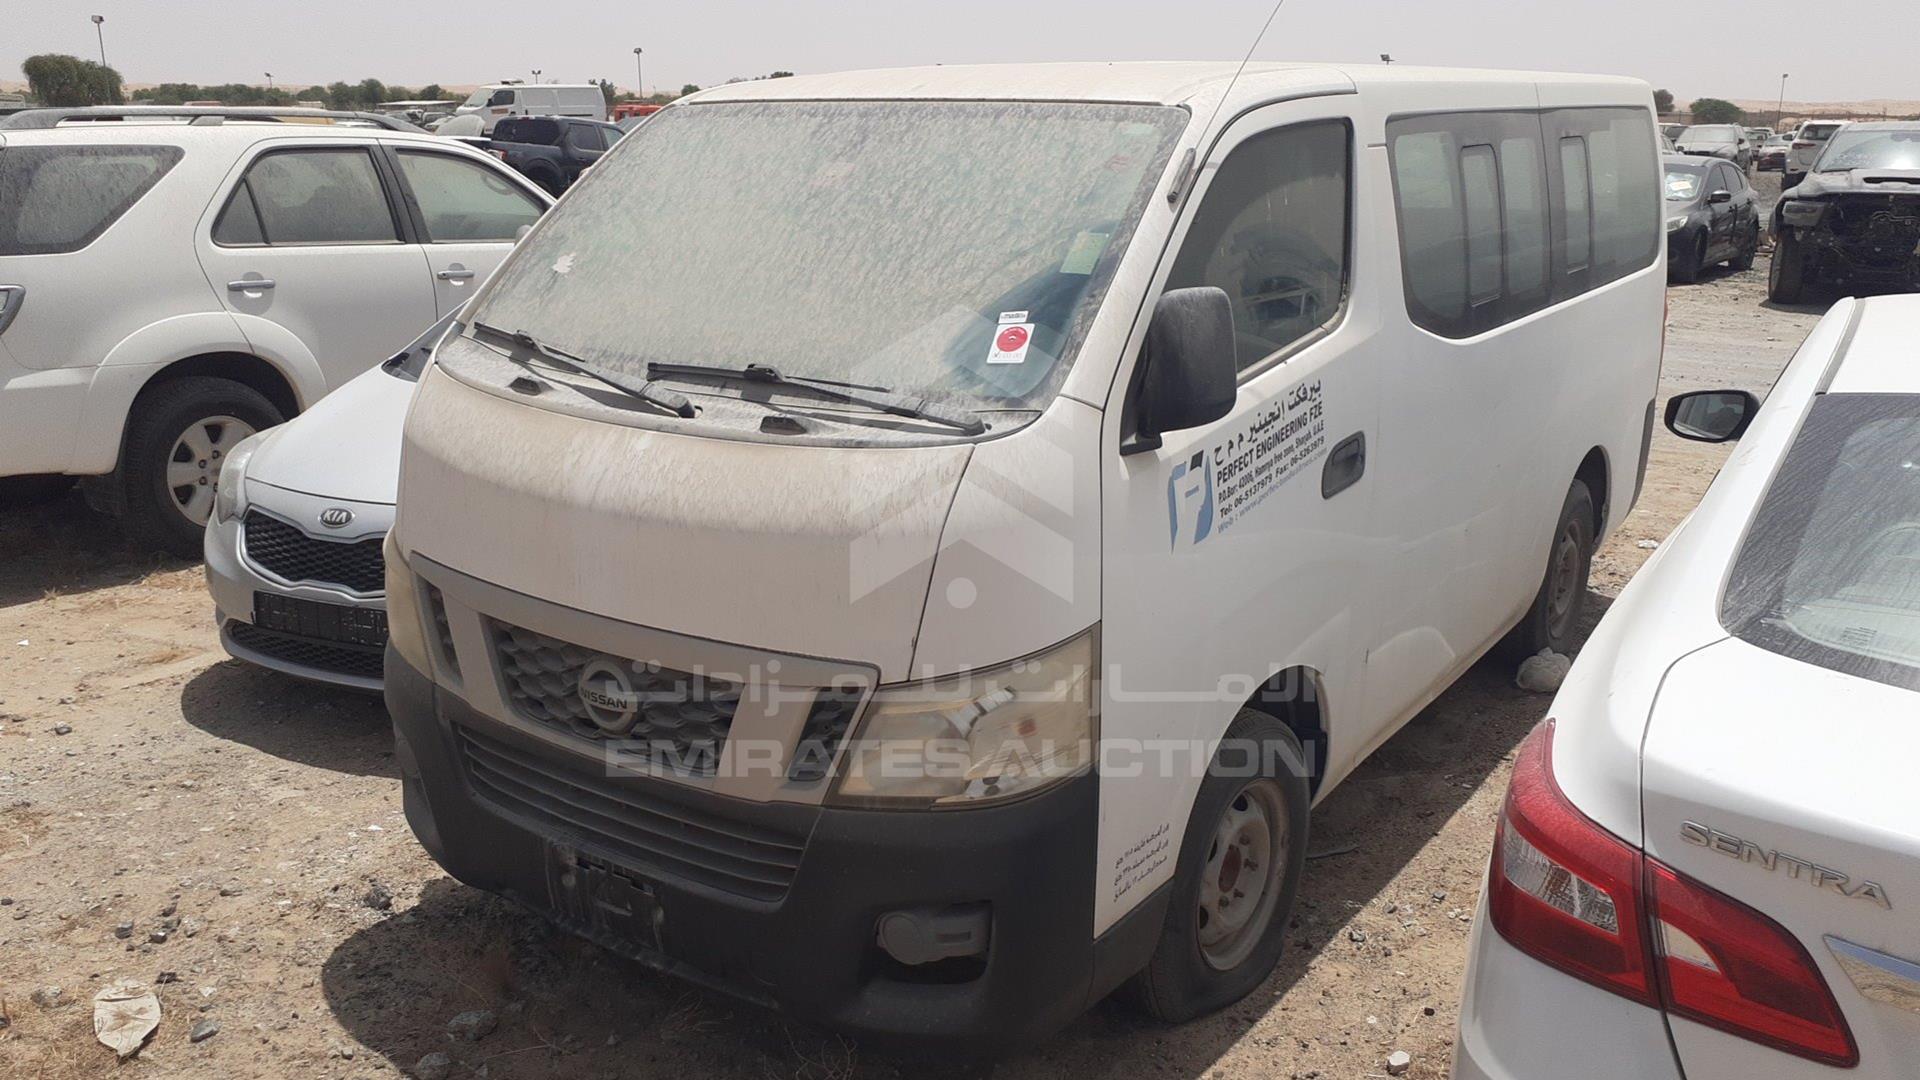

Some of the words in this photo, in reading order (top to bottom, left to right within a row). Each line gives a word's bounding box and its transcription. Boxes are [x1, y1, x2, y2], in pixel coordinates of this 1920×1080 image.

[1217, 448, 1254, 487] PERFECT
[1256, 411, 1308, 459] ENGINEERING
[1309, 401, 1323, 422] FZE
[323, 510, 347, 523] KIA
[581, 687, 628, 710] NISSAN
[1680, 819, 1892, 910] SENTRA
